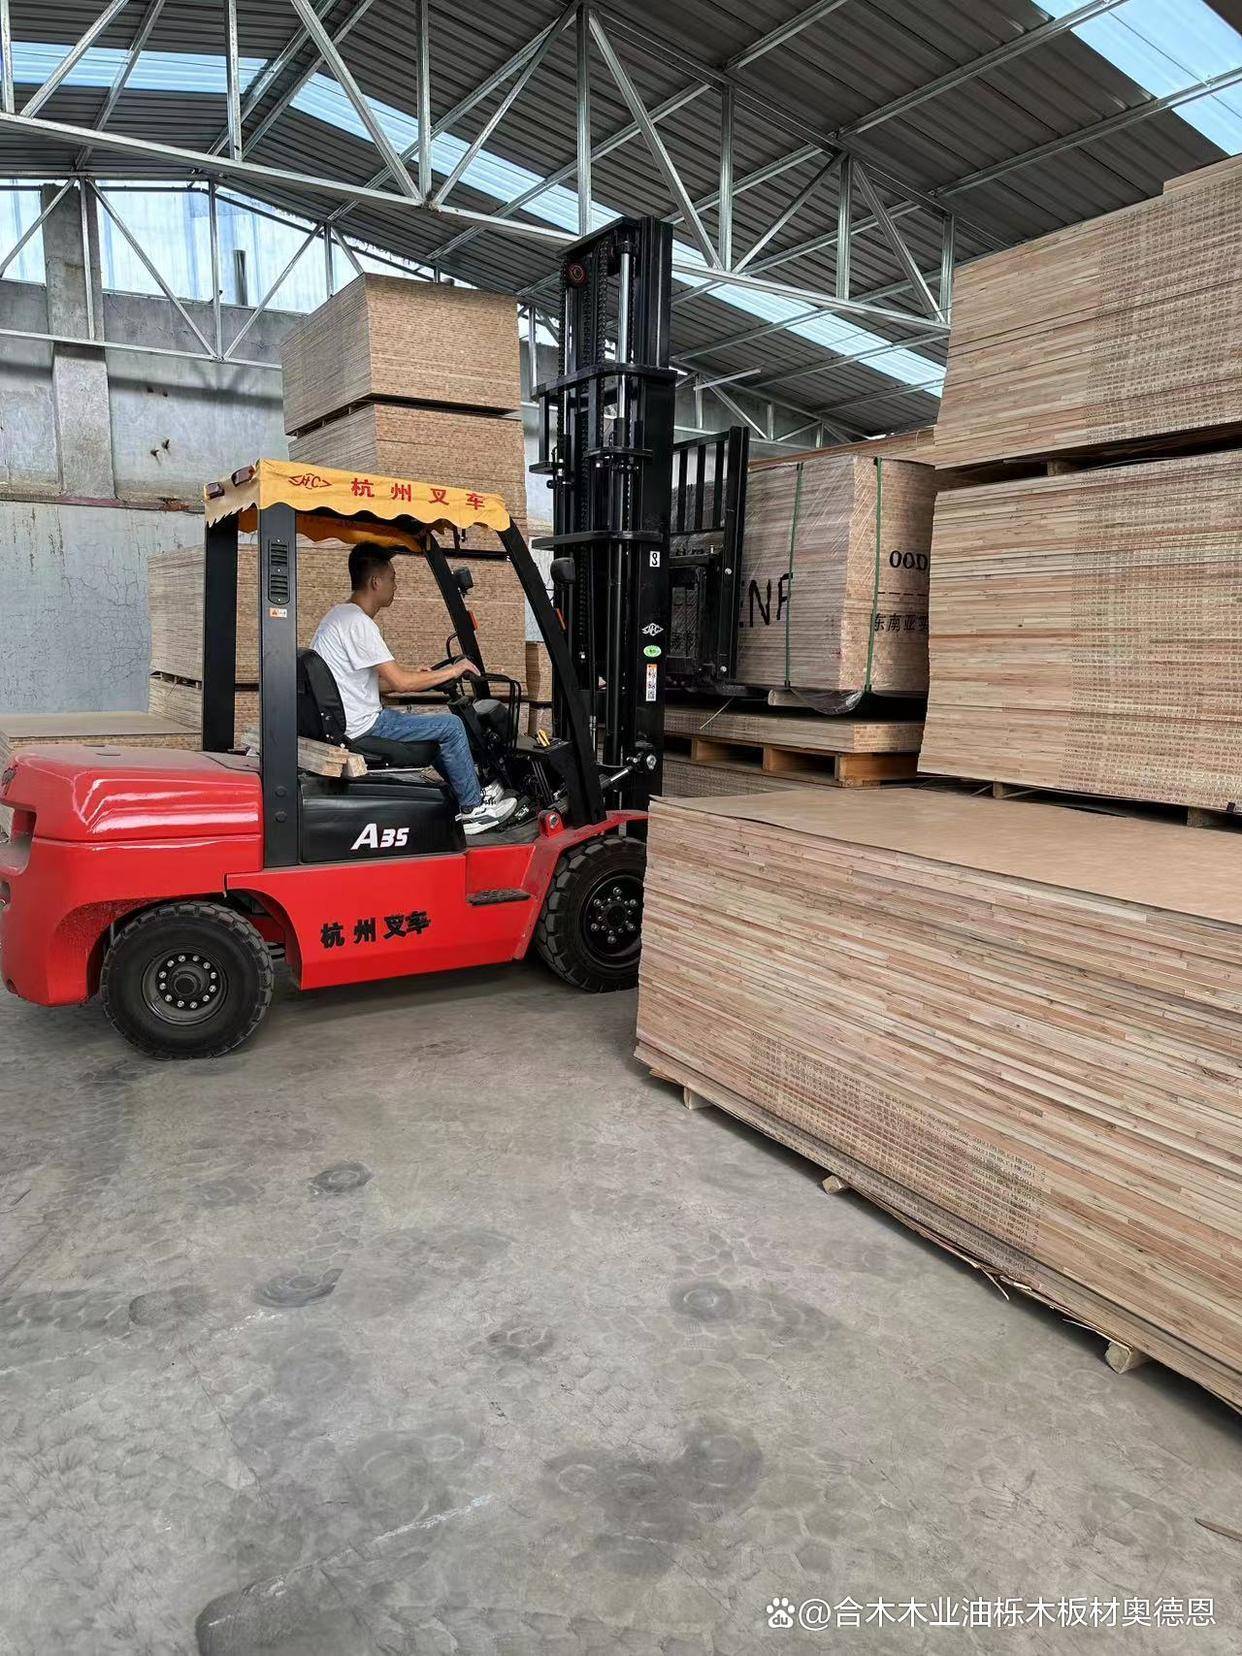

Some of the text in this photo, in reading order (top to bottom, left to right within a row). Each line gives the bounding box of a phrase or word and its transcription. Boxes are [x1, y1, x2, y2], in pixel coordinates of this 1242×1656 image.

[351, 478, 485, 511] 杭州叉车
[739, 572, 793, 628] NF
[351, 823, 410, 850] A35
[321, 911, 431, 948] 杭州叉车
